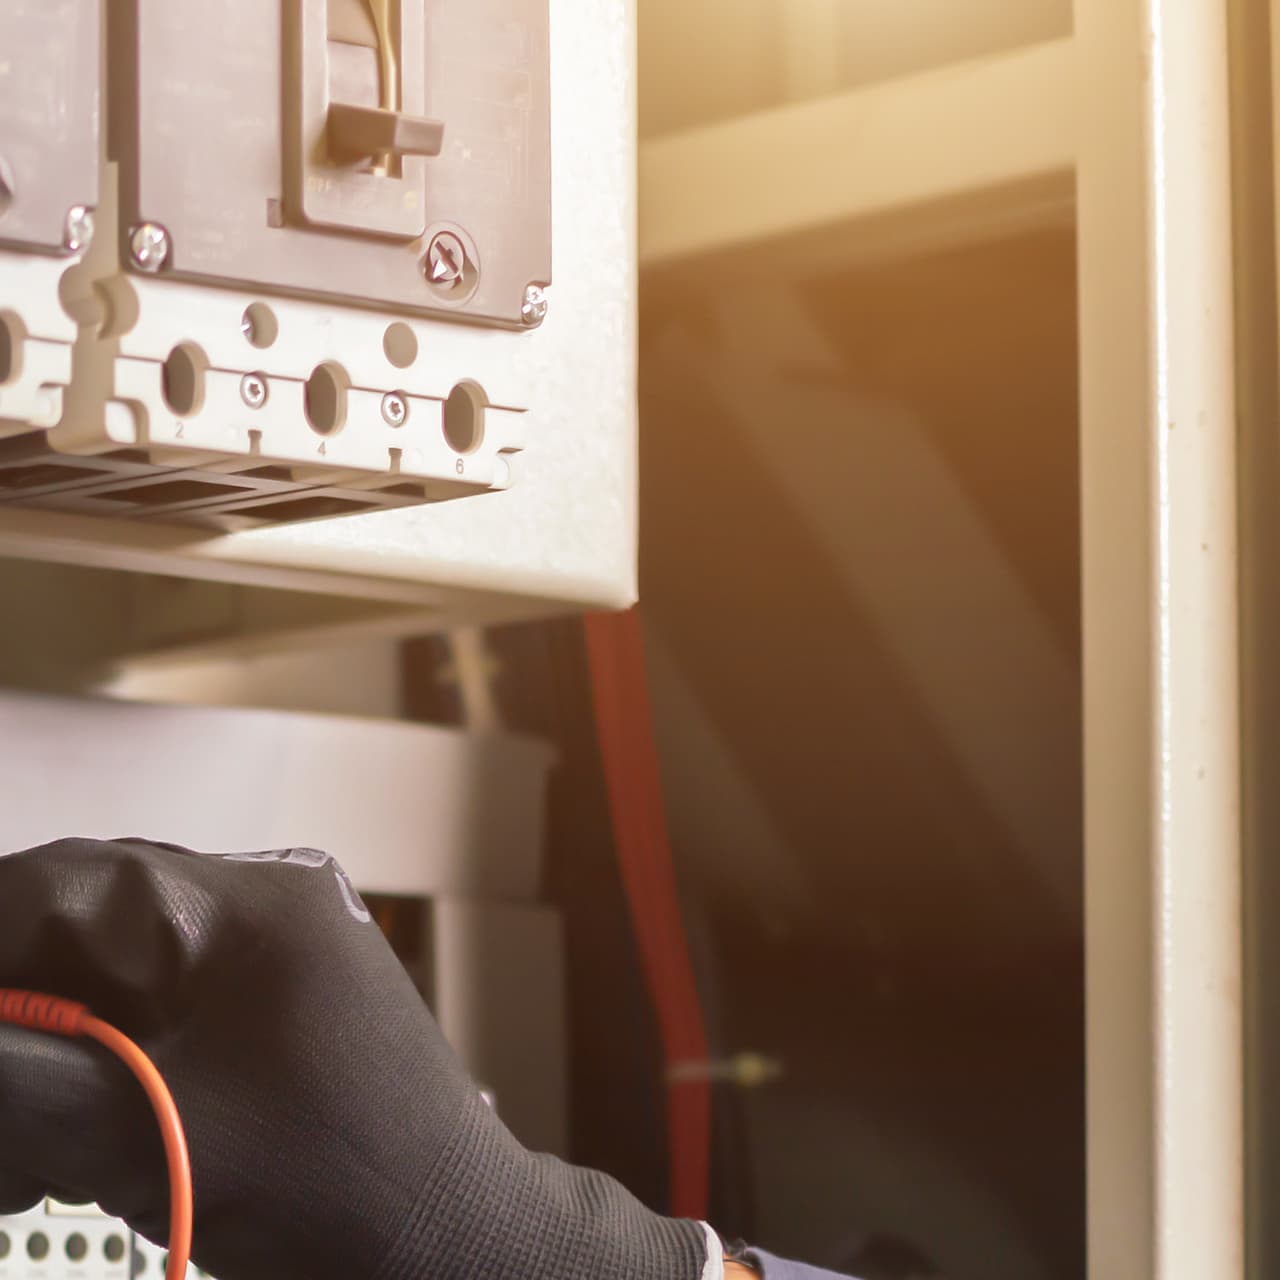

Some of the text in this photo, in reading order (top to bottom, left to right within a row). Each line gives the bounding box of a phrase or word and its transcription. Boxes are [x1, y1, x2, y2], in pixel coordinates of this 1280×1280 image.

[175, 421, 185, 440] 2
[317, 441, 327, 457] 4
[455, 457, 465, 475] 6
